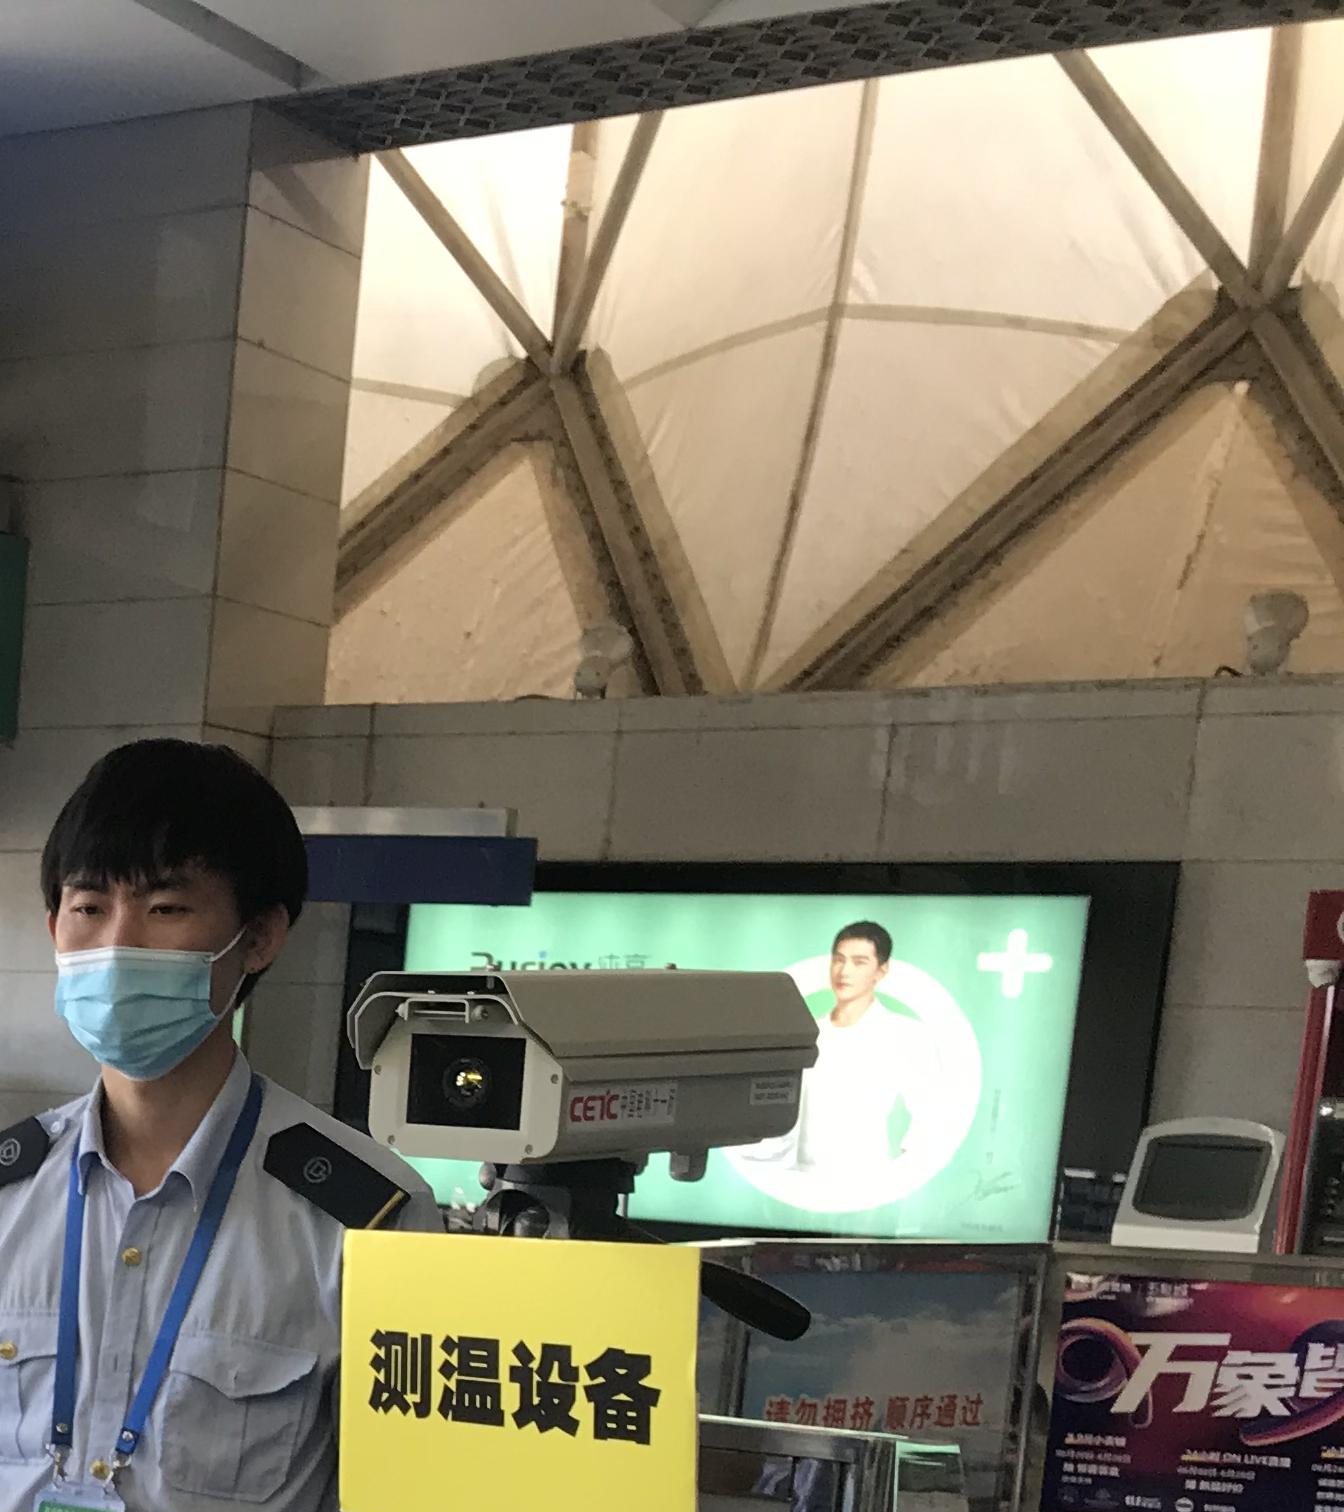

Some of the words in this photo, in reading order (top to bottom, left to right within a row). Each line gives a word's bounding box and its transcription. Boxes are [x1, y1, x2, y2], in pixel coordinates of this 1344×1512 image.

[570, 1089, 619, 1122] CETC
[369, 1329, 661, 1445] 测温设备
